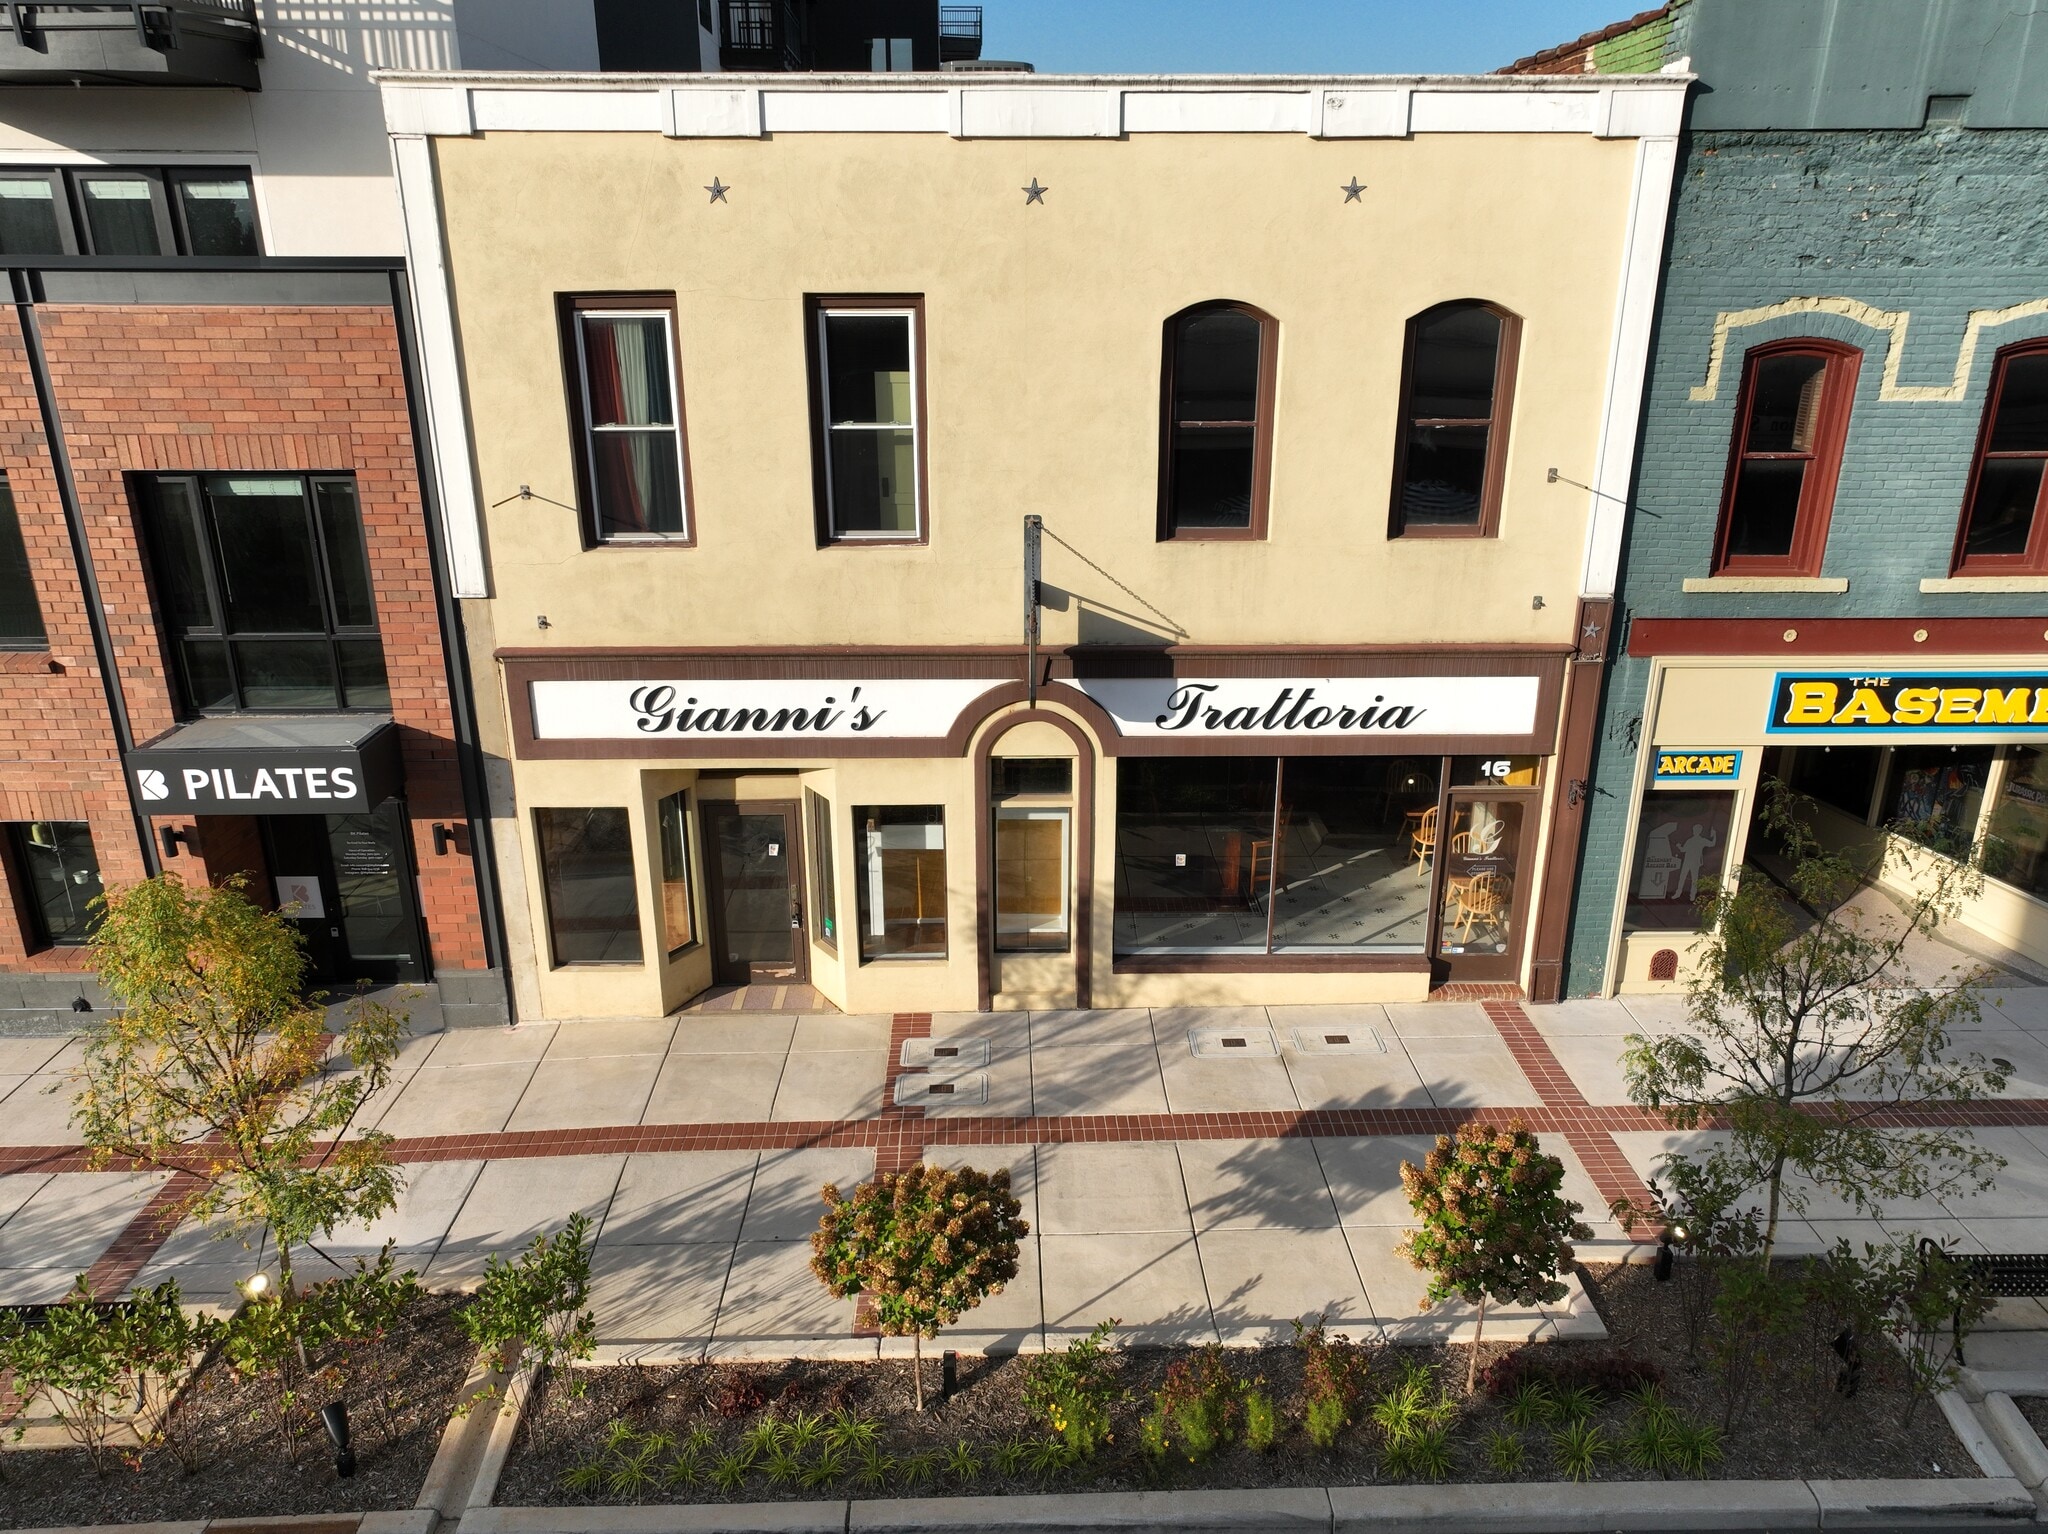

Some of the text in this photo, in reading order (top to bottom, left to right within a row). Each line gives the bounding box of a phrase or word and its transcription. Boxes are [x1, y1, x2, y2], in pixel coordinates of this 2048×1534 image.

[1849, 677, 1892, 687] THE
[629, 685, 888, 733] Gianni's
[1155, 683, 1428, 731] Trattoria
[1481, 760, 1512, 777] 16
[1657, 754, 1736, 775] ARCADE
[182, 767, 358, 800] PILATES
